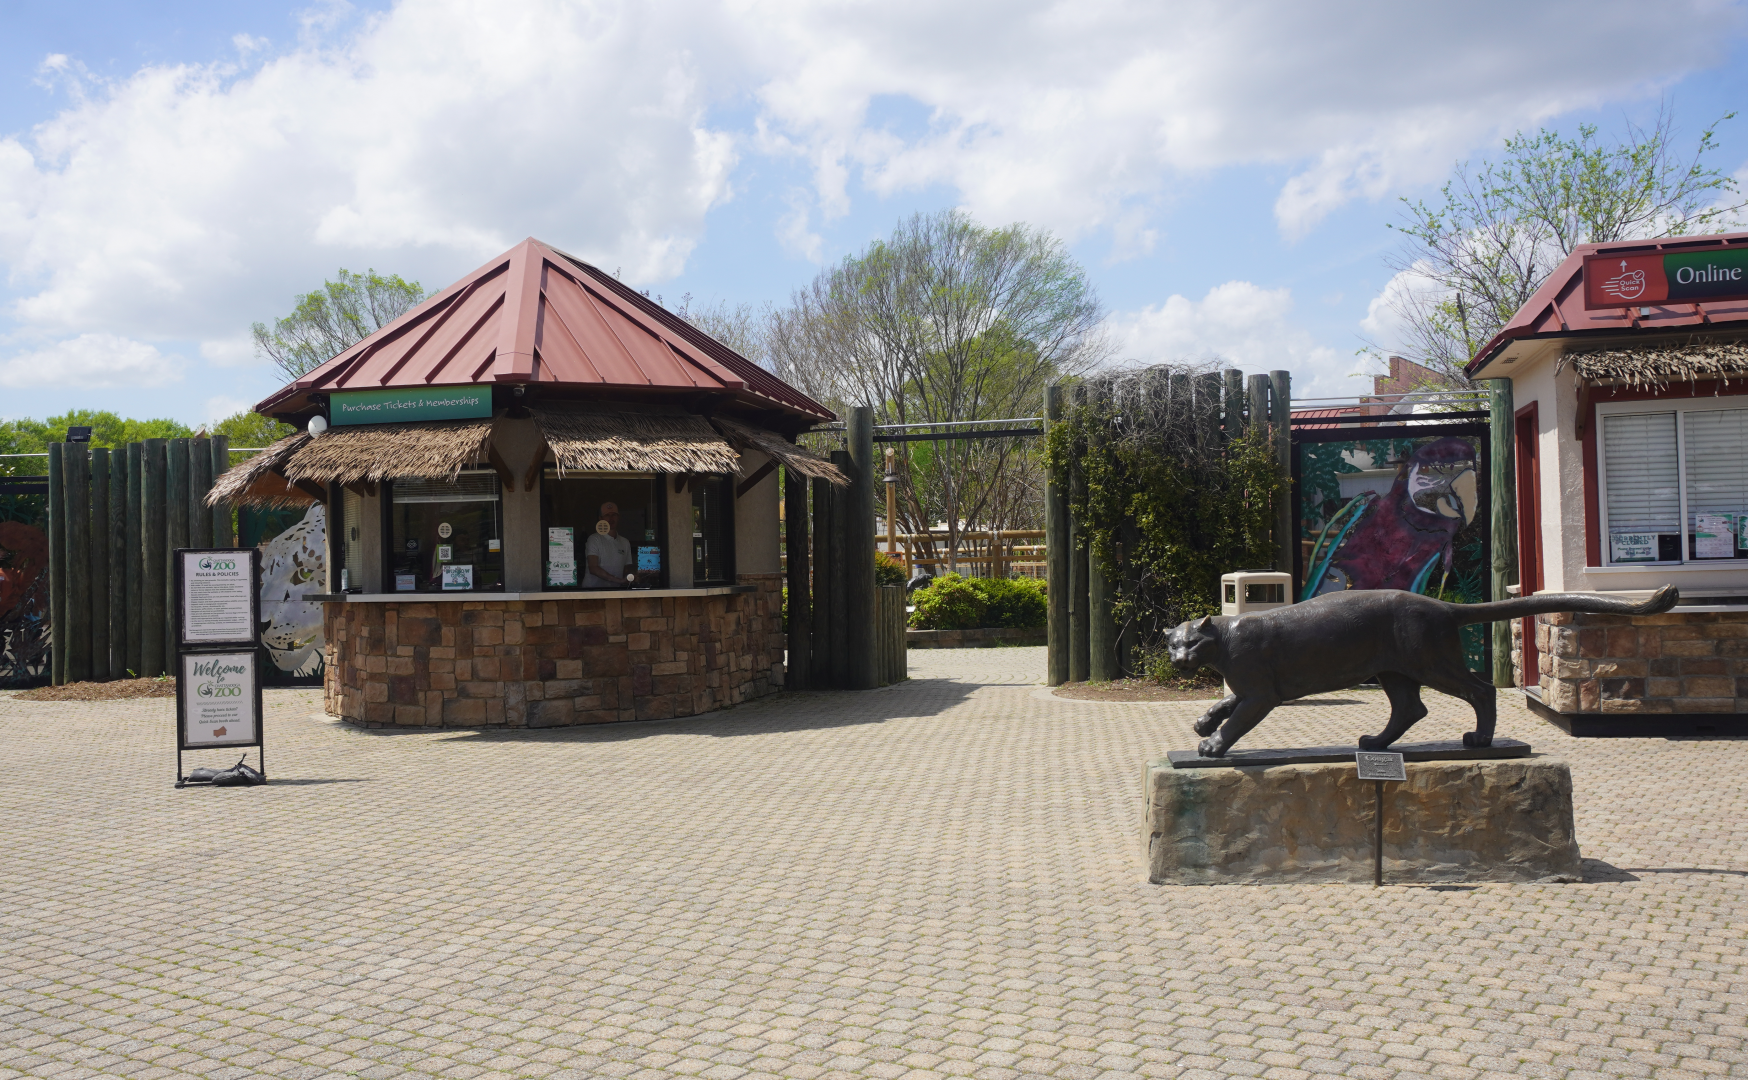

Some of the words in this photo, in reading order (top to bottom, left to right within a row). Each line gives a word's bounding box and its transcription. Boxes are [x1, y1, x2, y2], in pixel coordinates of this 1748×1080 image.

[1676, 264, 1742, 284] Online
[342, 402, 382, 412] Purchase
[383, 401, 417, 410] Tickets
[426, 396, 479, 408] Memberships
[212, 562, 236, 571] ZOO
[193, 659, 246, 677] Welcome
[214, 687, 242, 698] ZOO
